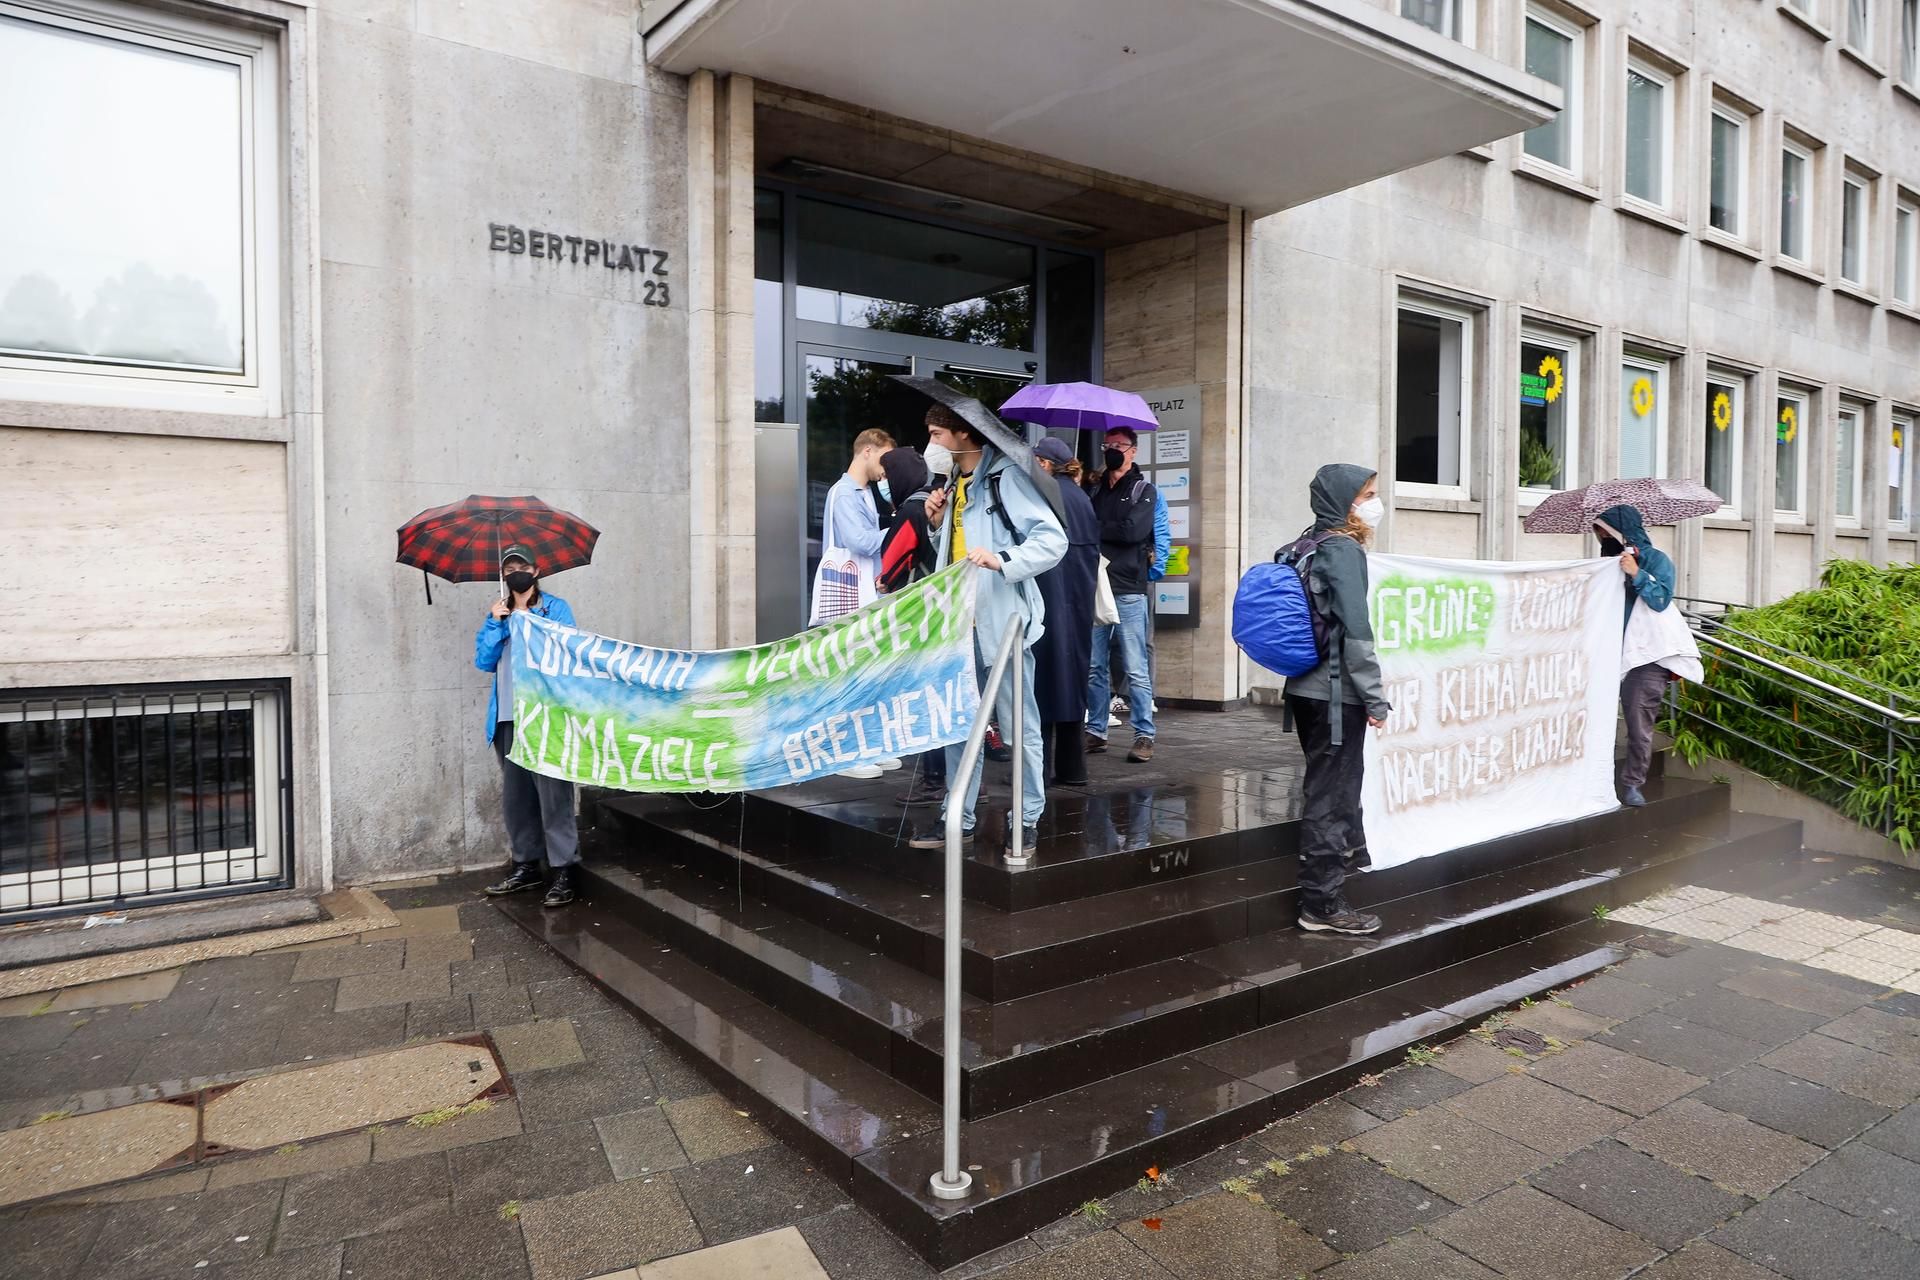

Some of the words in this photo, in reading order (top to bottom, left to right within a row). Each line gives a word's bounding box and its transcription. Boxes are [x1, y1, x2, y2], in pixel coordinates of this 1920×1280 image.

[489, 222, 669, 276] EBERTPLATZ
[643, 280, 671, 307] 23
[1377, 583, 1491, 649] GRÜNE:
[782, 671, 966, 779] BRECHEN!
[1377, 679, 1421, 737] HR
[1441, 662, 1516, 723] KLIMA
[1523, 650, 1583, 704] AUCH
[1383, 747, 1450, 814] NACH
[1457, 735, 1505, 790] DER
[1511, 710, 1588, 775] WAHL?
